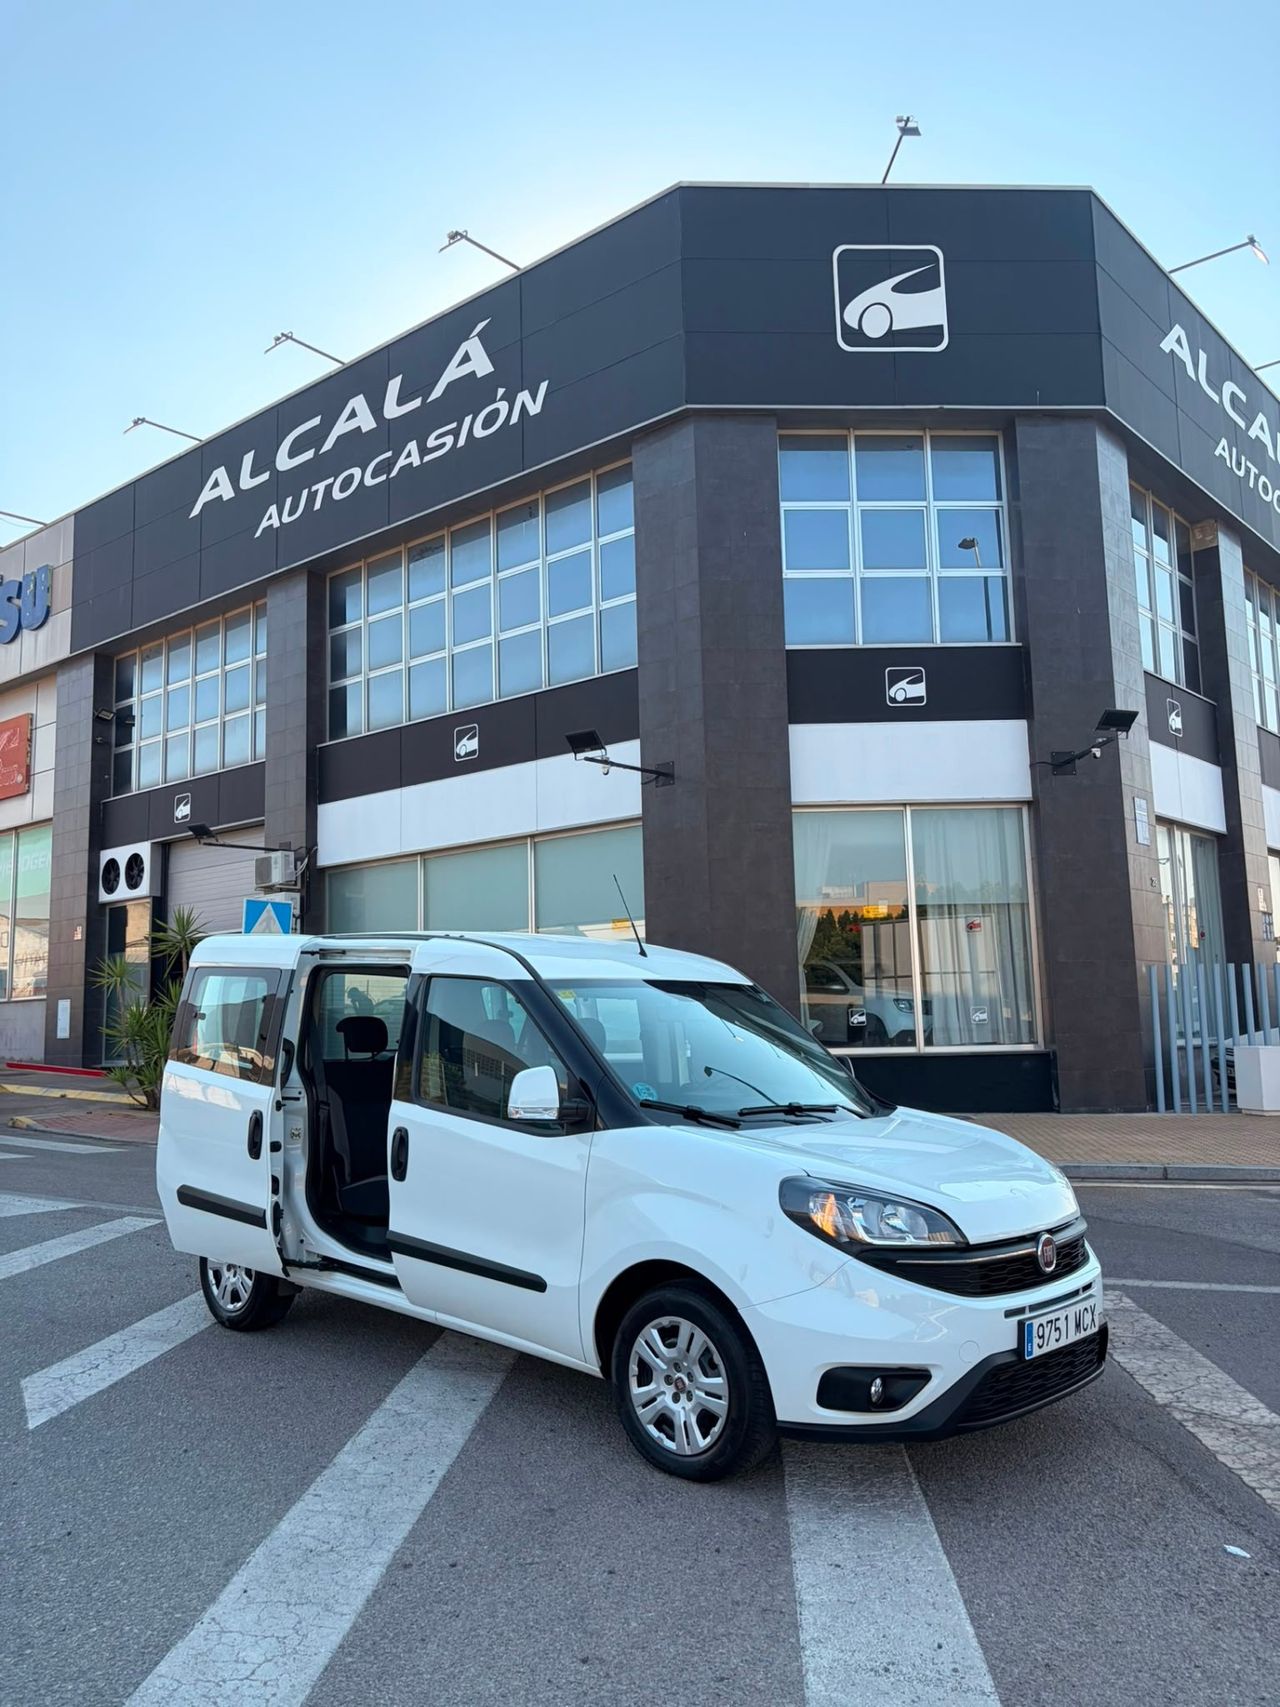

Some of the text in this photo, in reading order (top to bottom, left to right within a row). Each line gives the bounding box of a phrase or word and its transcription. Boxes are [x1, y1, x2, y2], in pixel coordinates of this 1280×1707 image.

[189, 317, 495, 519] ALCALÁ
[254, 379, 549, 539] AUTOCASIÓN
[1159, 323, 1280, 463] ALCA
[0, 564, 53, 644] SU
[1036, 1303, 1096, 1350] 9751 MCX
